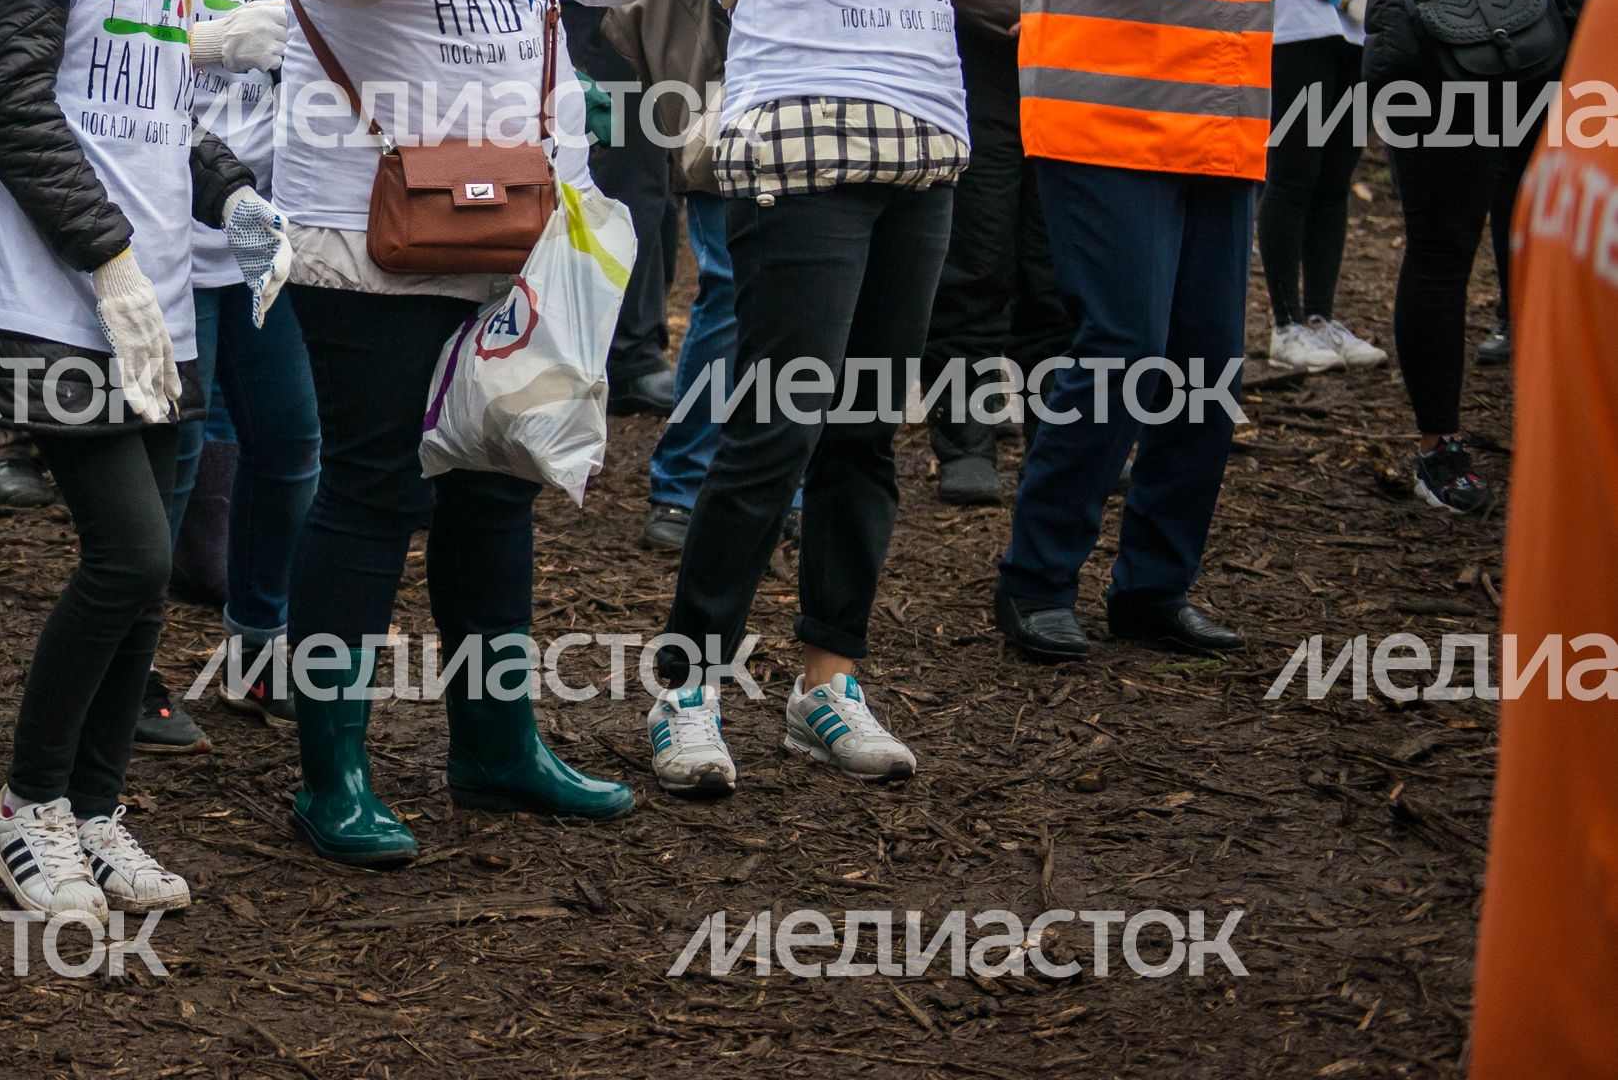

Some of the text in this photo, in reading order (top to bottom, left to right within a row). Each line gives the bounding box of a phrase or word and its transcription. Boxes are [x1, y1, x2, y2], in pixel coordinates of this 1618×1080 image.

[841, 7, 892, 28] ПОСАДИ
[900, 8, 925, 29] СВОЕ
[439, 42, 507, 65] ПОСАДИ
[88, 37, 159, 110] НАШ
[81, 111, 136, 140] ПОСАДИ
[145, 120, 170, 146] СВОЕ
